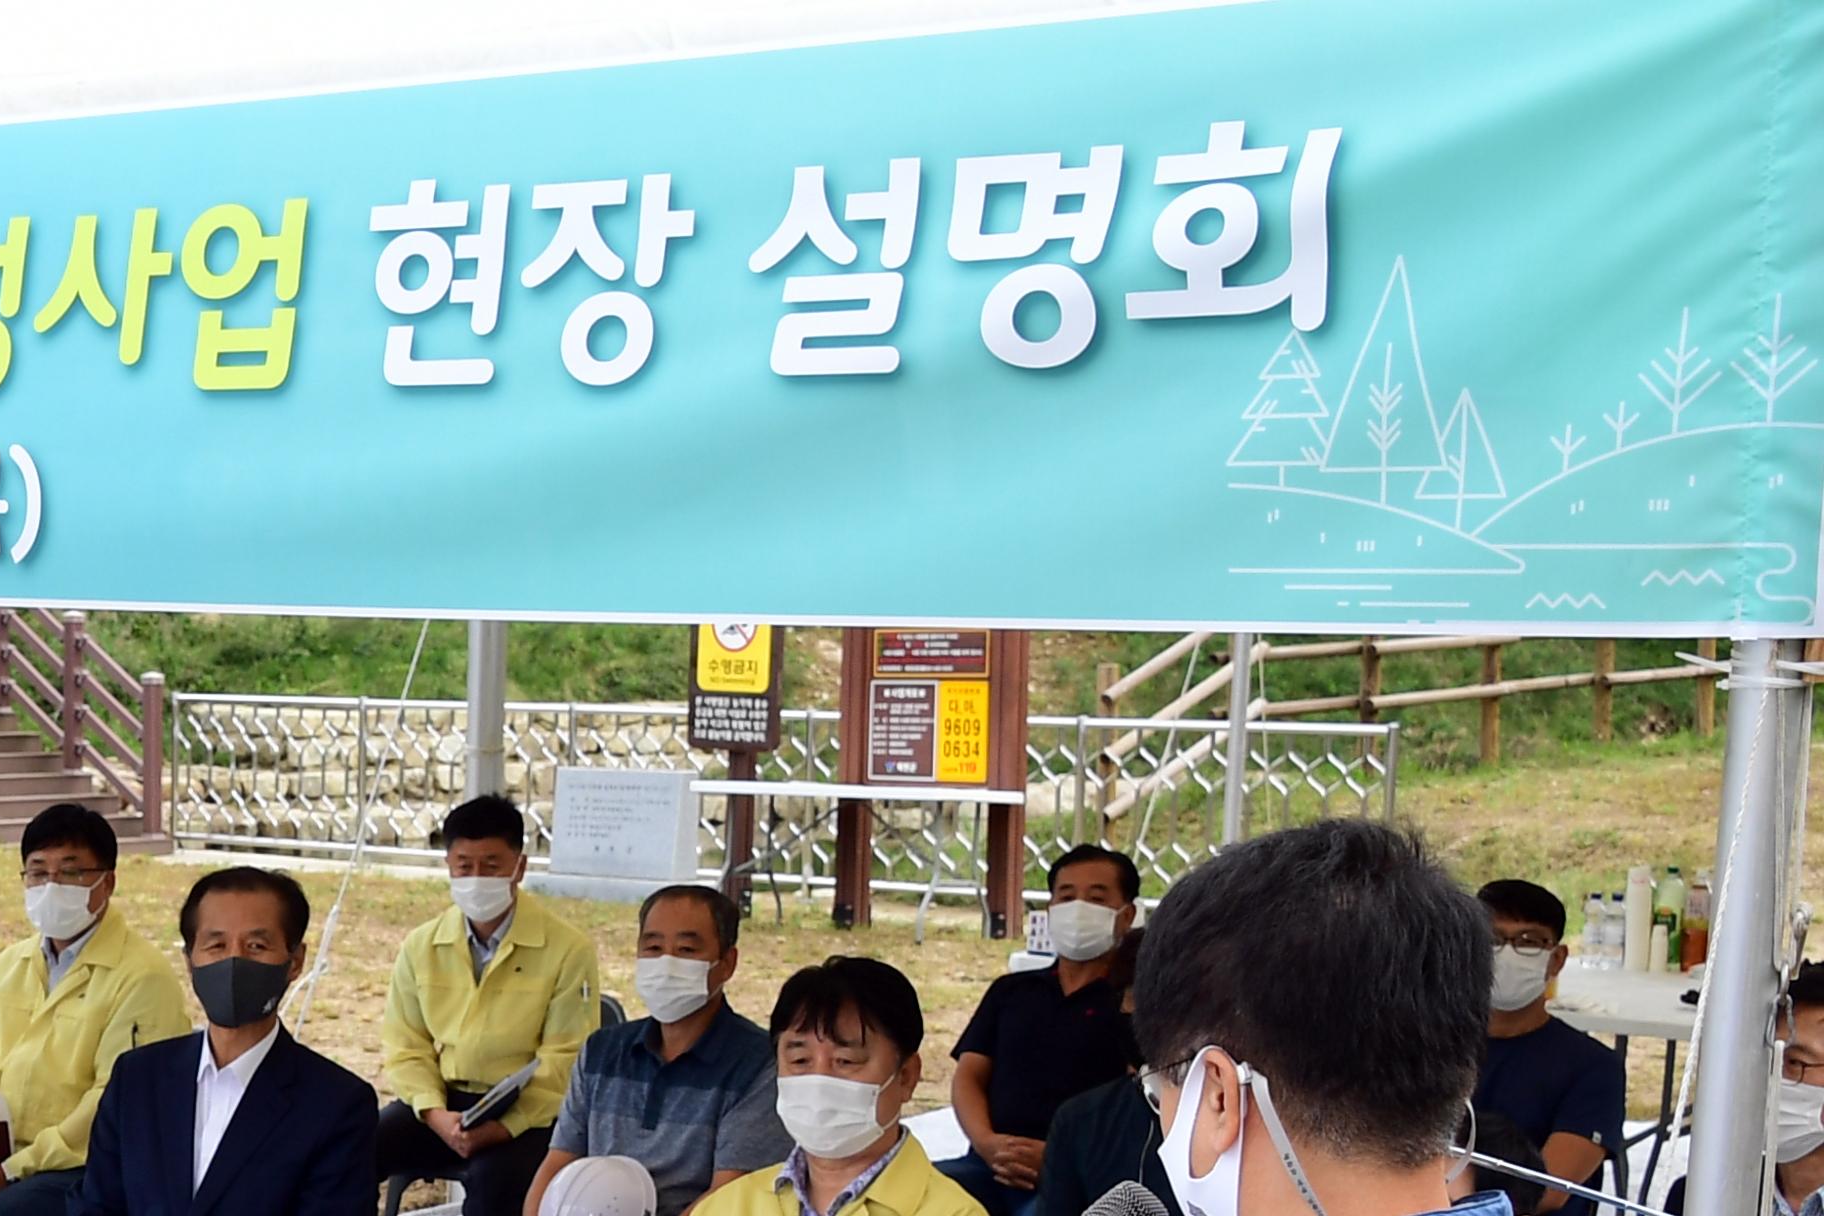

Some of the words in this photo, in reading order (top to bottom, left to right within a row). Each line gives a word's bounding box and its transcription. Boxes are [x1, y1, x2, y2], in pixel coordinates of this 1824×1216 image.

[368, 172, 696, 388] 현장
[747, 119, 1344, 378] 설명회
[707, 659, 758, 676] 수영금지
[944, 718, 980, 736] 9609
[943, 740, 980, 758] 0634
[959, 762, 977, 774] 119
